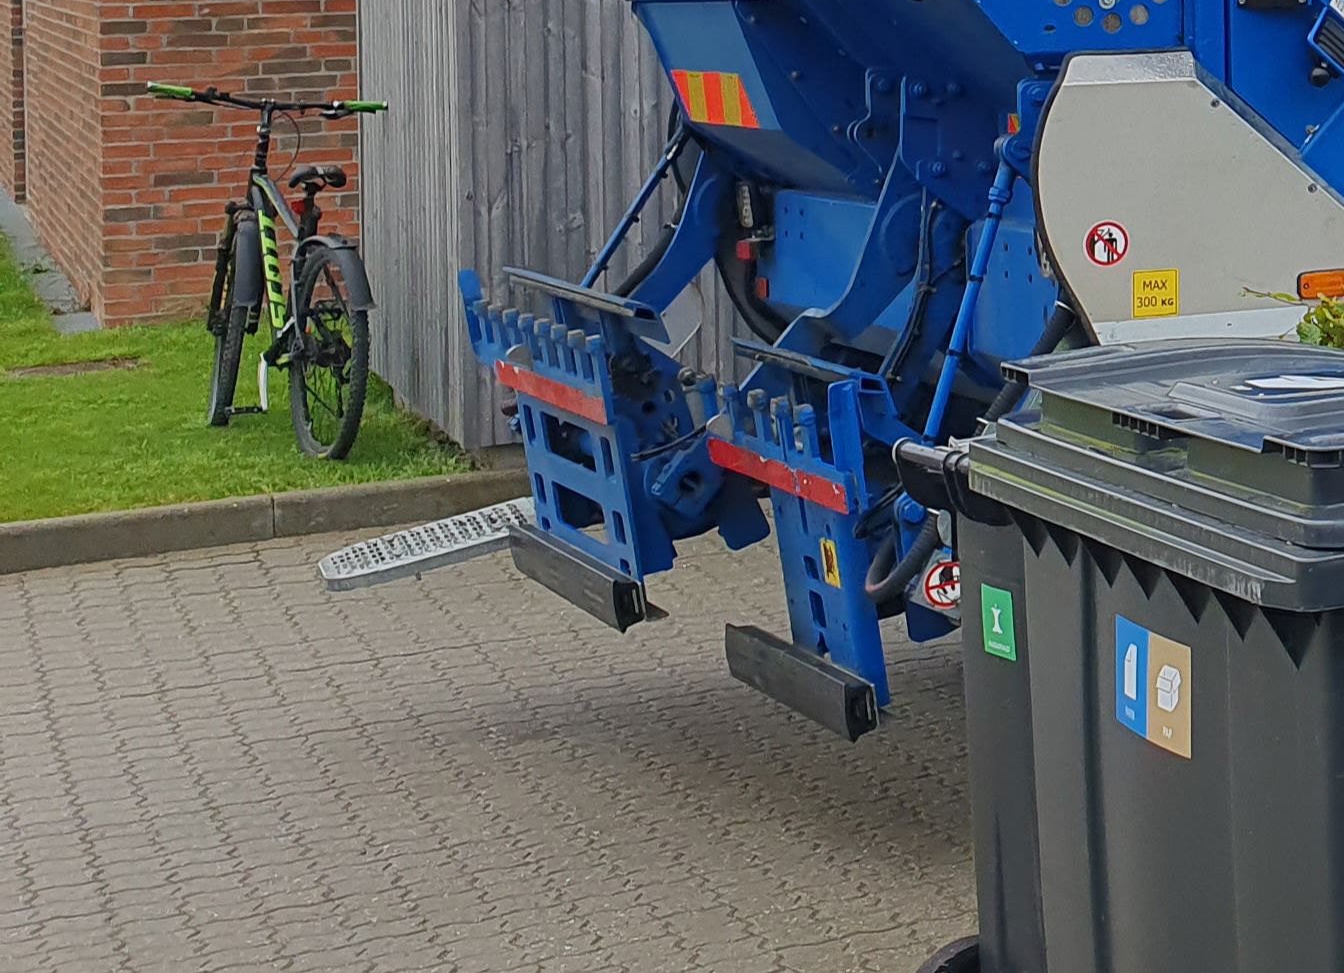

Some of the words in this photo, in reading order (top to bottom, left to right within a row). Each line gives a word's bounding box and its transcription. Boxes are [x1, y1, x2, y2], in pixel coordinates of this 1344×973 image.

[258, 210, 286, 328] SCOTT
[1142, 280, 1167, 292] MAX
[1137, 296, 1157, 308] 300
[1161, 298, 1174, 307] KG
